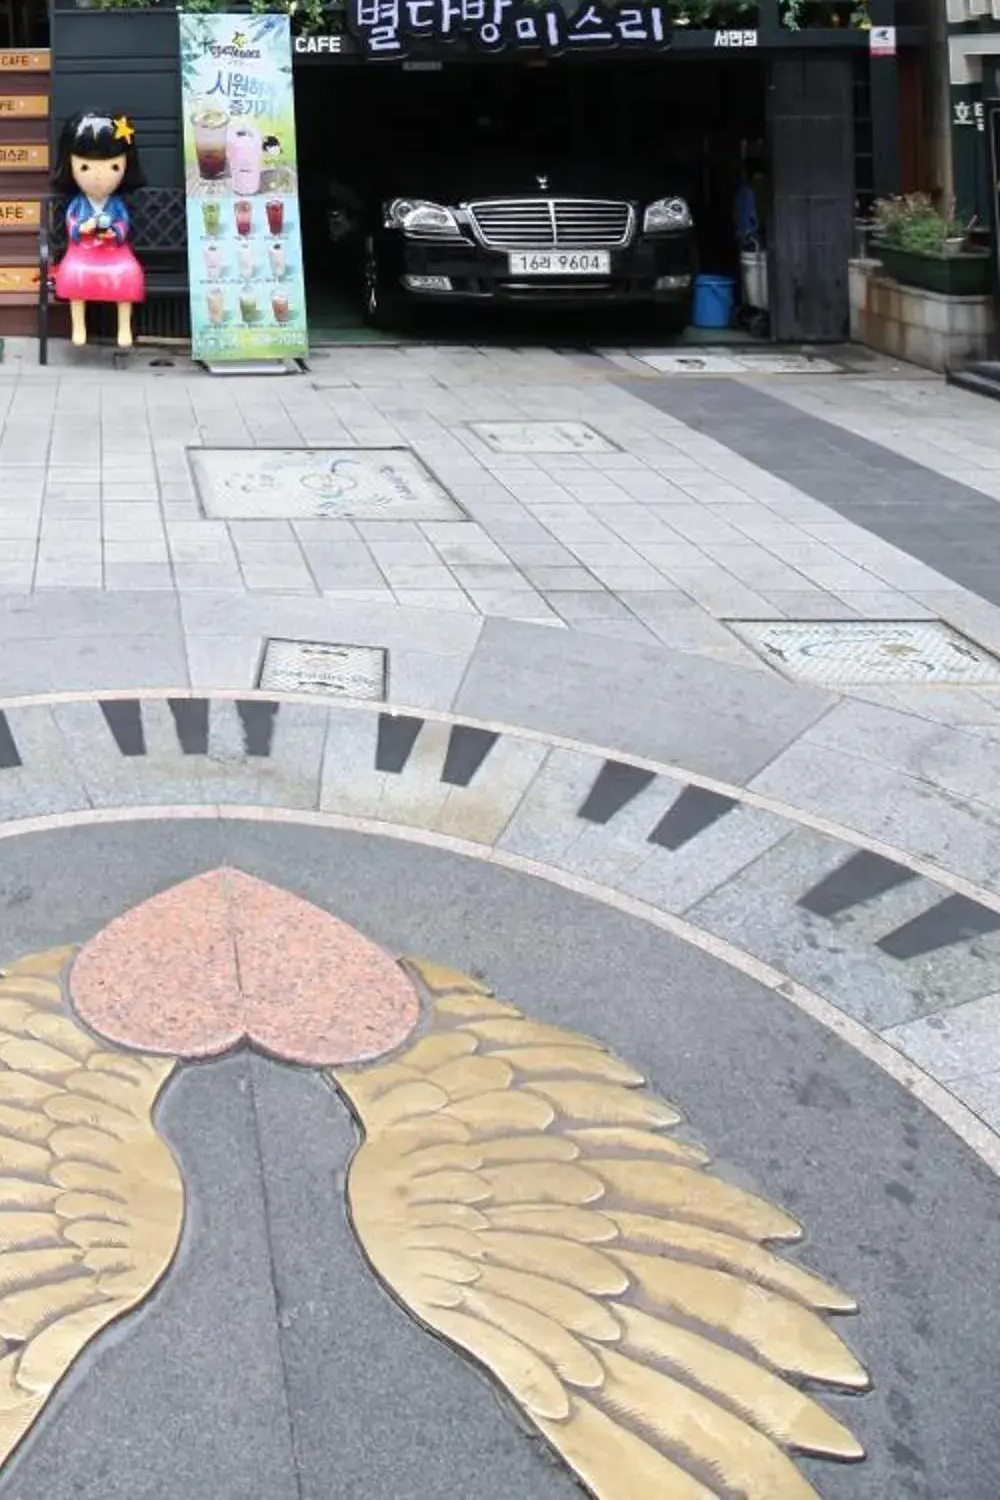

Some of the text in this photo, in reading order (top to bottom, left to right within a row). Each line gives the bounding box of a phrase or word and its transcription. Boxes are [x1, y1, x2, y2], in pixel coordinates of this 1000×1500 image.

[295, 37, 341, 53] CAFE
[713, 29, 757, 47] 서면점
[1, 56, 29, 66] CAFE
[558, 255, 600, 270] 9604
